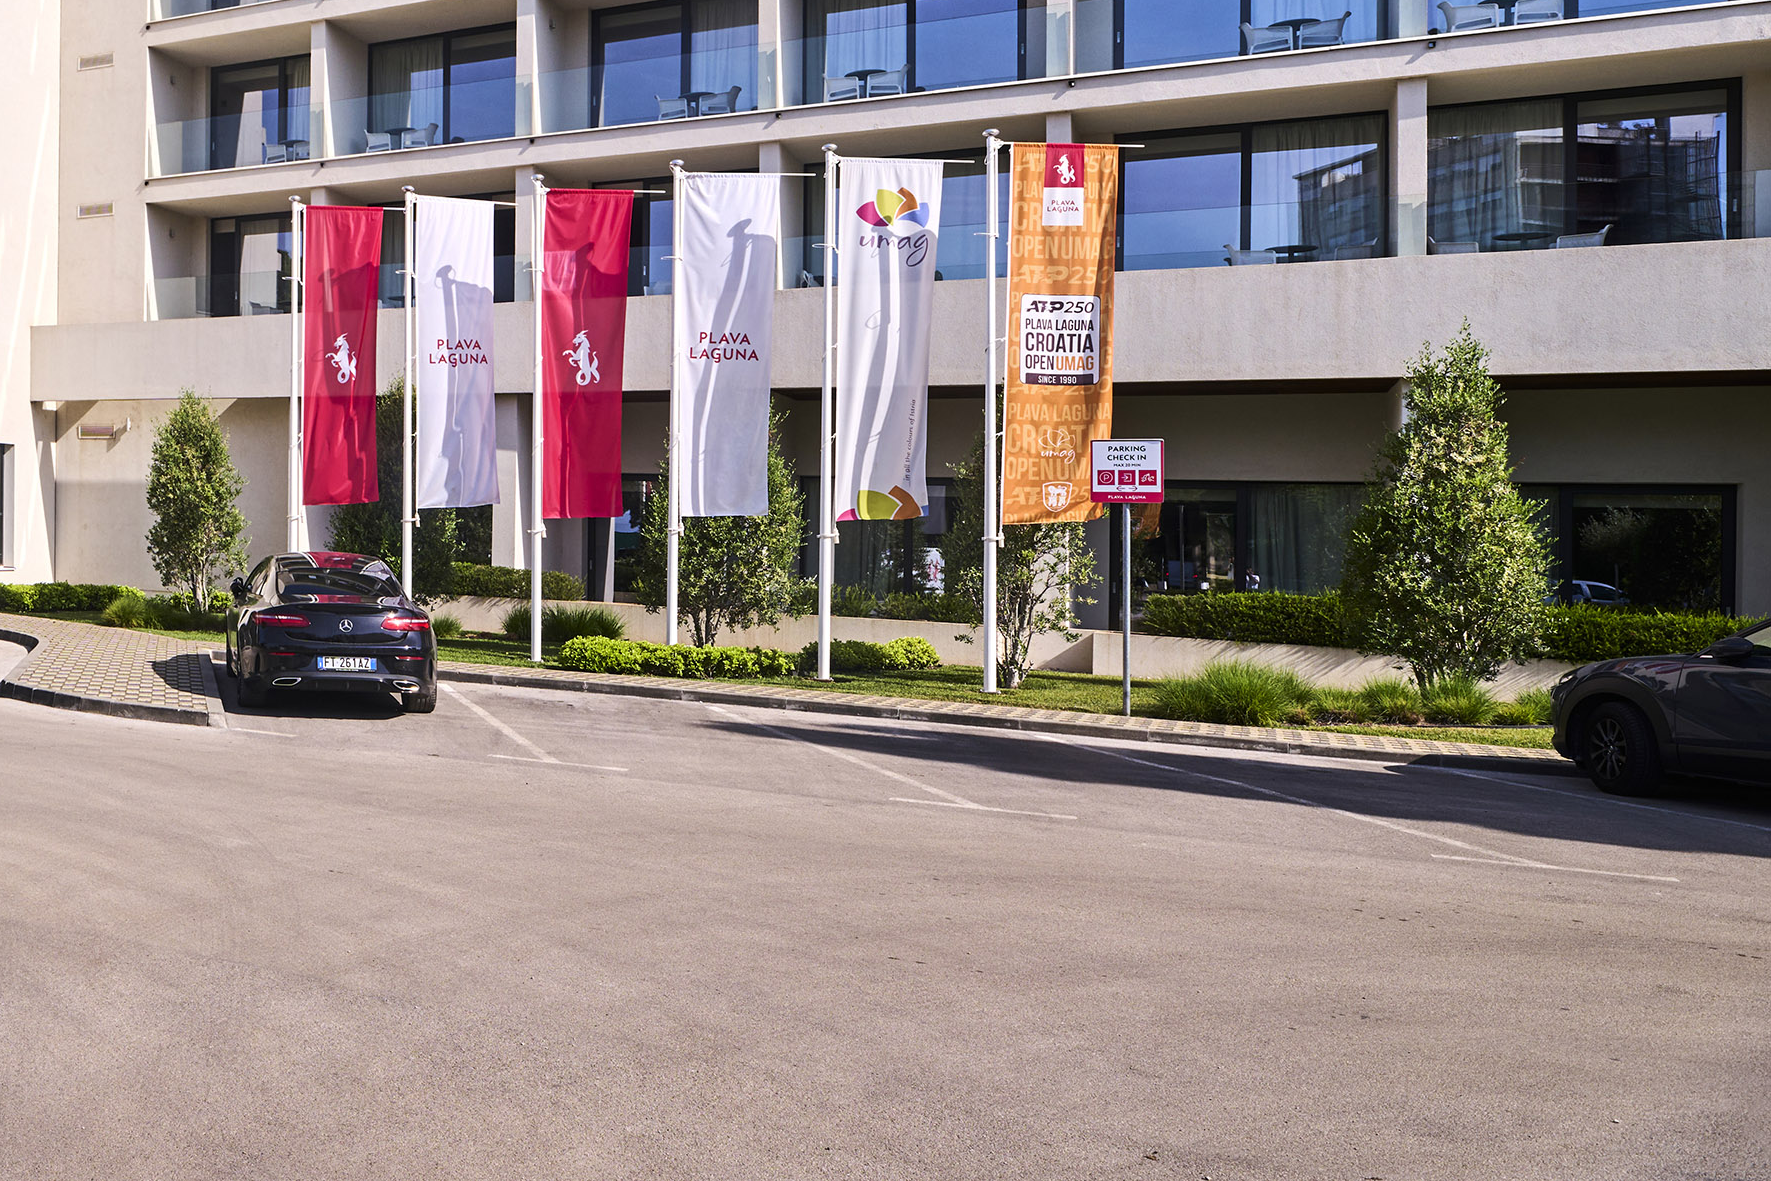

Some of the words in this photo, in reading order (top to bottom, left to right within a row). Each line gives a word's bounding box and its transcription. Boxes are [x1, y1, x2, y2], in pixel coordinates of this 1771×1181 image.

[859, 234, 928, 267] umag
[1025, 318, 1053, 330] PLAVA
[1055, 320, 1094, 331] LAGUNA
[437, 339, 482, 350] PLAVA
[700, 332, 751, 345] PLAVA
[1025, 332, 1095, 353] CROATIA
[429, 353, 488, 367] LAGUNA
[689, 347, 759, 363] LAGUNA
[1059, 376, 1077, 384] 1990
[1008, 403, 1049, 420] PLAVA
[1053, 404, 1110, 421] LAGUNA
[1040, 448, 1075, 464] umag
[903, 464, 911, 473] all
[324, 657, 336, 667] FT
